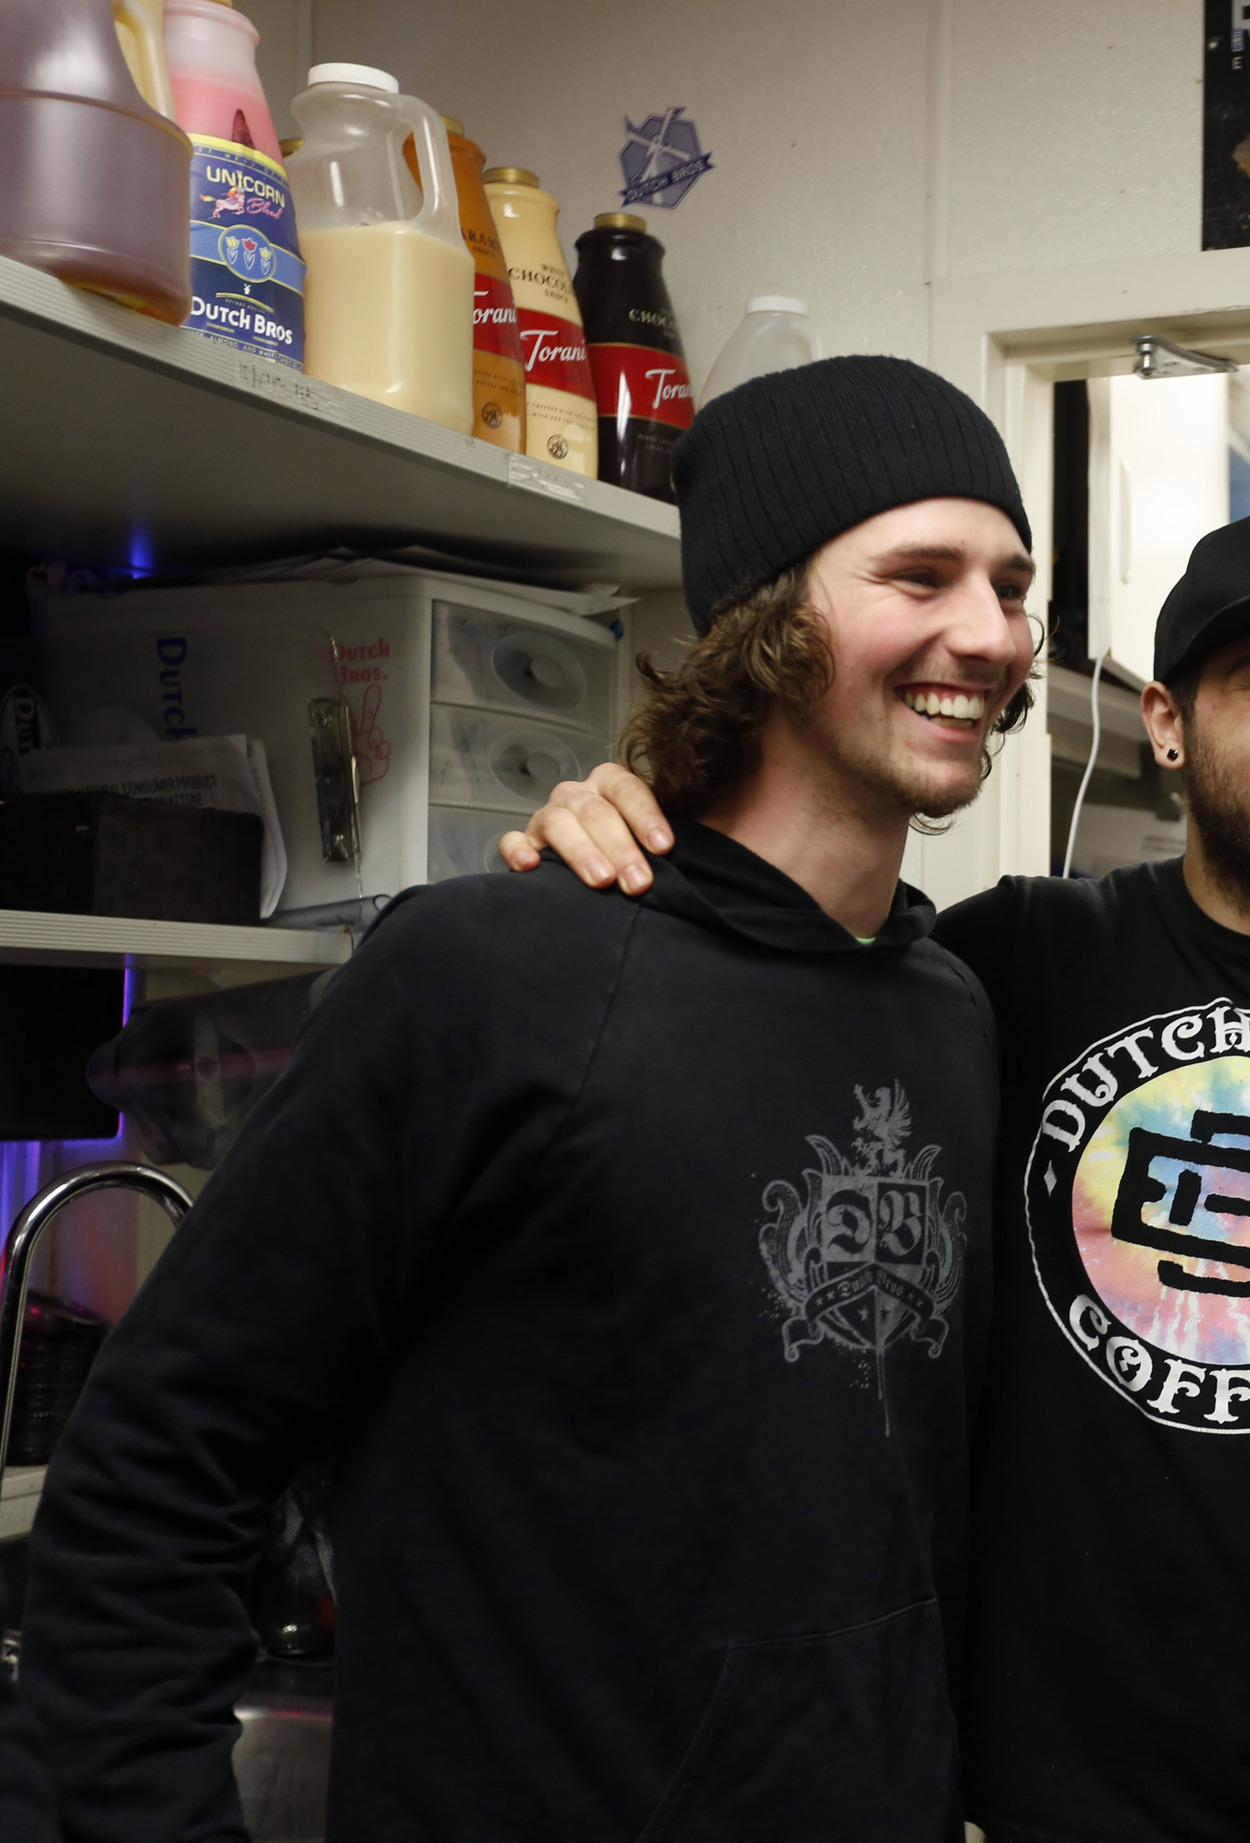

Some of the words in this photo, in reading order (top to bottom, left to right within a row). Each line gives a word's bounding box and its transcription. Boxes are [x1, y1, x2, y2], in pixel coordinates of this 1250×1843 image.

[206, 165, 285, 208] UNICORN
[246, 198, 284, 219] Blend
[254, 313, 293, 346] BROS
[520, 329, 586, 372] Torani
[122, 776, 174, 794] CONSUMER
[175, 773, 215, 789] PRODUCT
